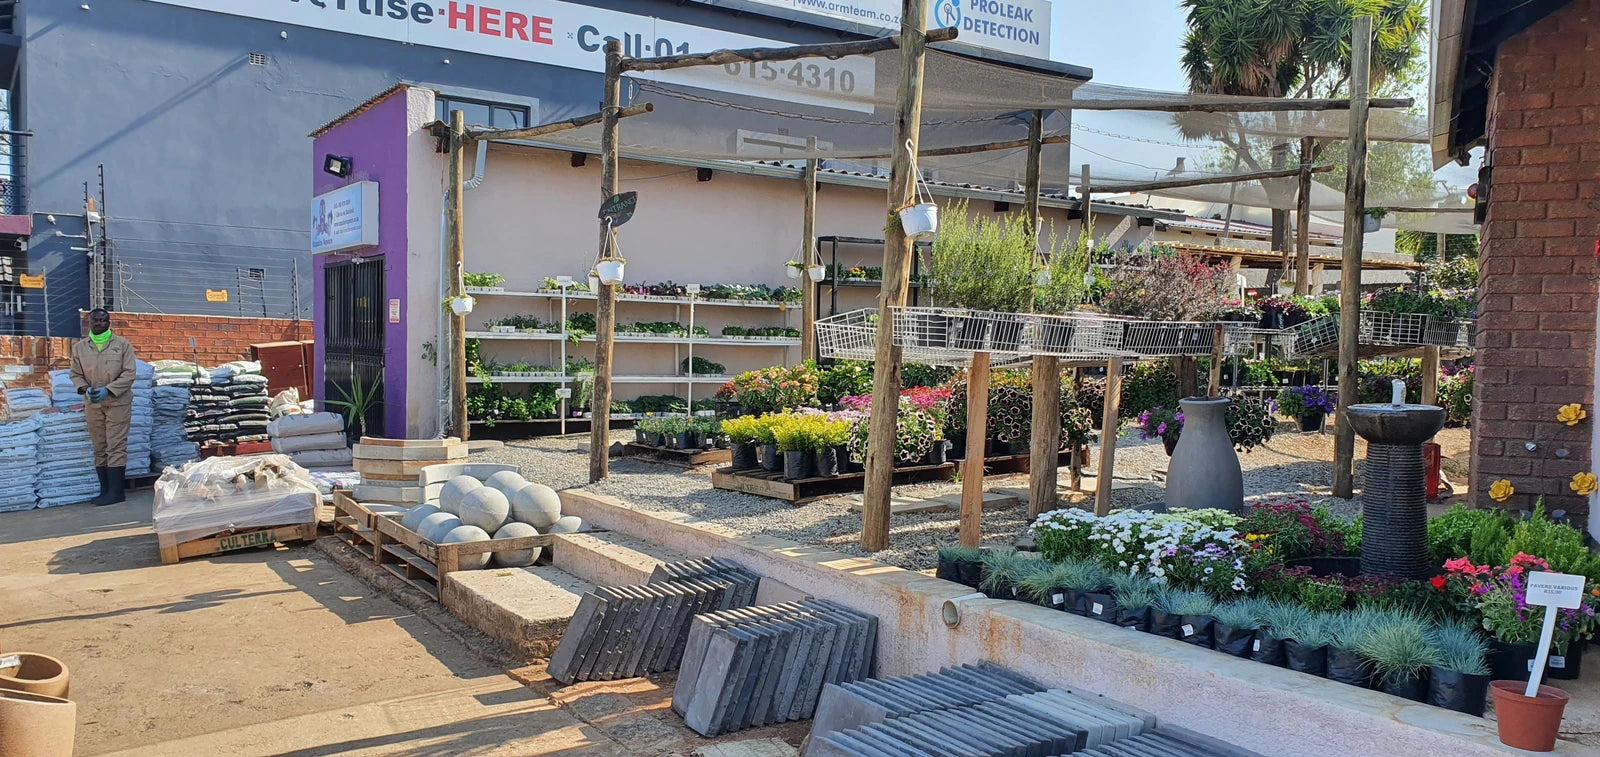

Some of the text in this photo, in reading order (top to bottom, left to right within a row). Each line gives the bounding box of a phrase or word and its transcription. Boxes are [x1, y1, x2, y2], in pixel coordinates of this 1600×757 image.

[448, 0, 553, 45] HERE
[970, 0, 1034, 23] PROLEAK
[963, 16, 1041, 46] DETECTION
[219, 531, 277, 550] CULTERRA
